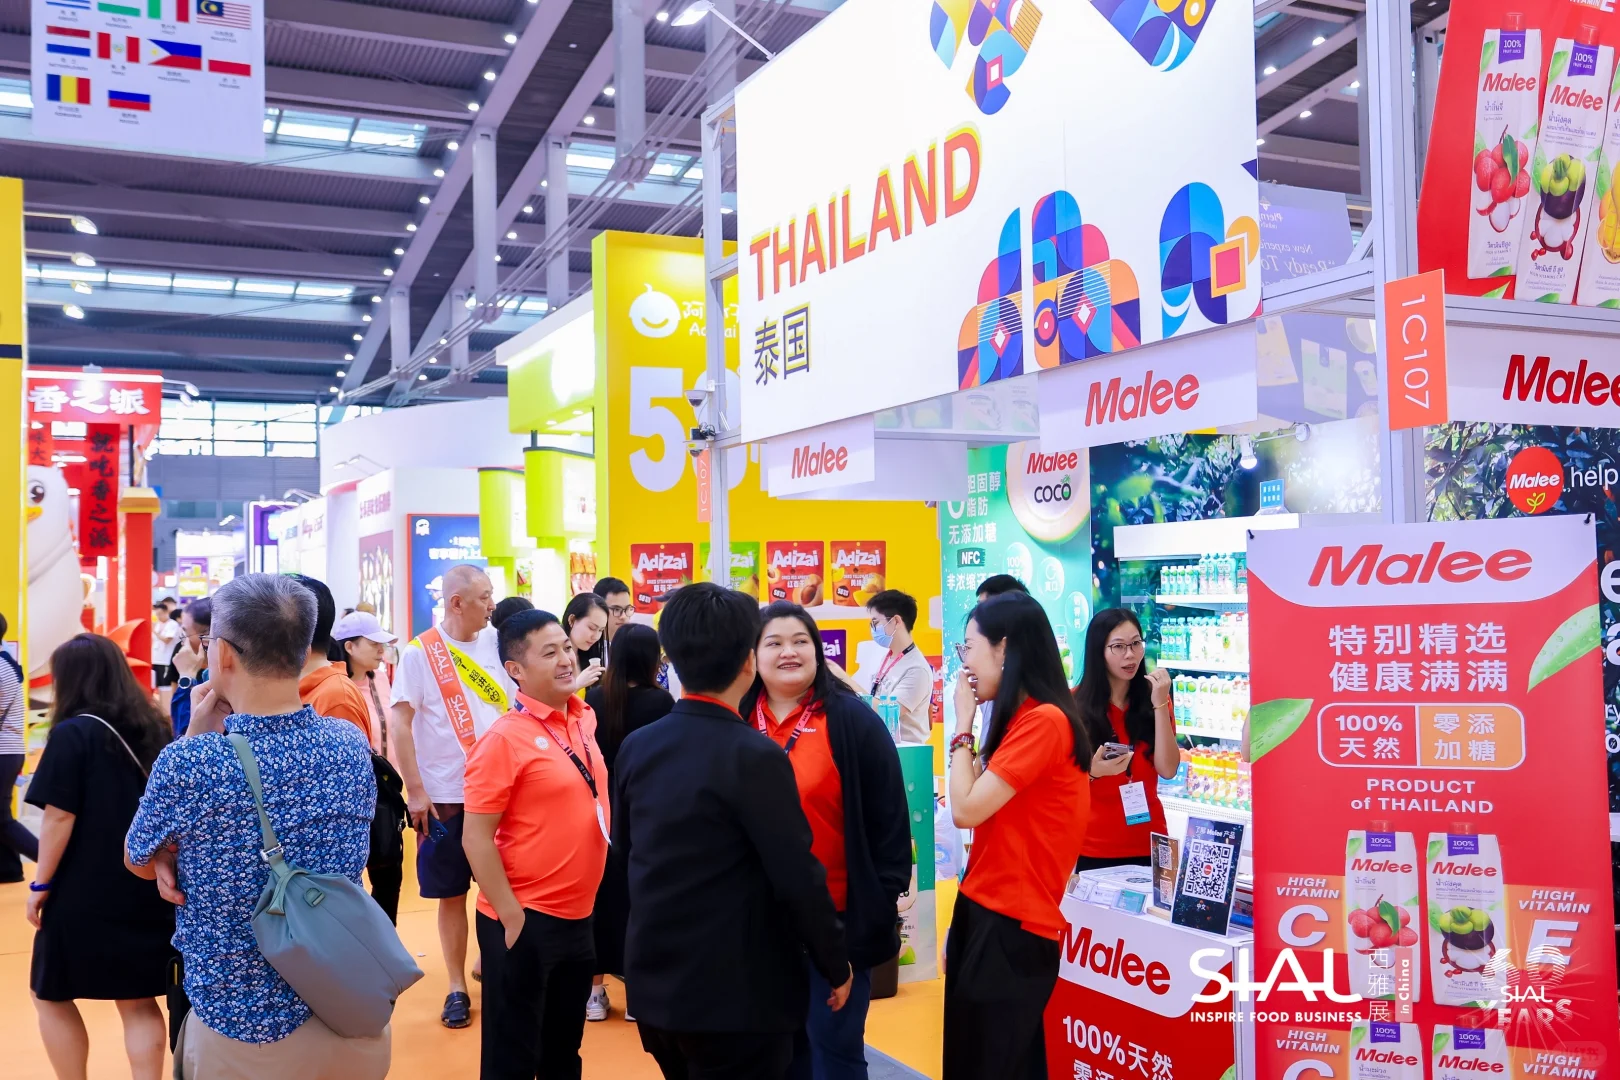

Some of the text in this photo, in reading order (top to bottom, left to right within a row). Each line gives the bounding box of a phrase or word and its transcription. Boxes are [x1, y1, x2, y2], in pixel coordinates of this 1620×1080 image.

[1503, 40, 1522, 48] 100%
[1574, 52, 1593, 64] 100%
[1482, 73, 1536, 92] Malee
[1549, 85, 1604, 111] Malee
[749, 124, 982, 302] THAILAND
[754, 302, 811, 386] 泰国
[1401, 293, 1429, 410] 1C107
[29, 385, 150, 415] 香之派
[1084, 370, 1200, 427] Malee
[791, 441, 848, 480] Malee
[1026, 452, 1078, 475] Malee
[1509, 471, 1560, 490] Malee
[1570, 465, 1619, 490] help
[967, 496, 989, 518] 脂肪
[948, 522, 997, 545] 无添加糖
[637, 552, 688, 572] Adizai
[772, 550, 819, 568] Adizai
[836, 549, 881, 567] Adizai
[961, 551, 981, 565] NFC
[1307, 541, 1533, 588] Malee
[947, 573, 998, 593] 非浓缩还
[1328, 622, 1507, 656] 特别精选
[430, 641, 450, 675] SIAL
[1328, 660, 1508, 693] 健康满满
[450, 694, 470, 729] SIAL
[1334, 714, 1403, 732] 100%
[1433, 712, 1496, 736] 零添
[1338, 736, 1401, 760] 天然
[1434, 739, 1497, 763] 加糖
[1366, 778, 1476, 794] PRODUCT
[1350, 796, 1494, 815] of THAILAND
[1351, 858, 1413, 874] Malee
[1432, 862, 1497, 877] Malee
[1287, 876, 1326, 888] HIGH
[1276, 886, 1340, 900] VITAMIN
[1531, 889, 1575, 902] HIGH
[1196, 903, 1206, 911] 中文
[1517, 900, 1590, 914] VITAMIN
[1277, 904, 1329, 947] C
[1059, 923, 1171, 995] Malee
[1287, 1029, 1327, 1042] HIGH
[1375, 1027, 1397, 1035] 100%
[1458, 1033, 1481, 1041] 100%
[1276, 1039, 1341, 1054] VITAMIN
[1355, 1048, 1419, 1066] Malee
[1438, 1055, 1505, 1073] Malee
[1535, 1052, 1581, 1067] HIGH
[1523, 1063, 1596, 1080] VITAMIN
